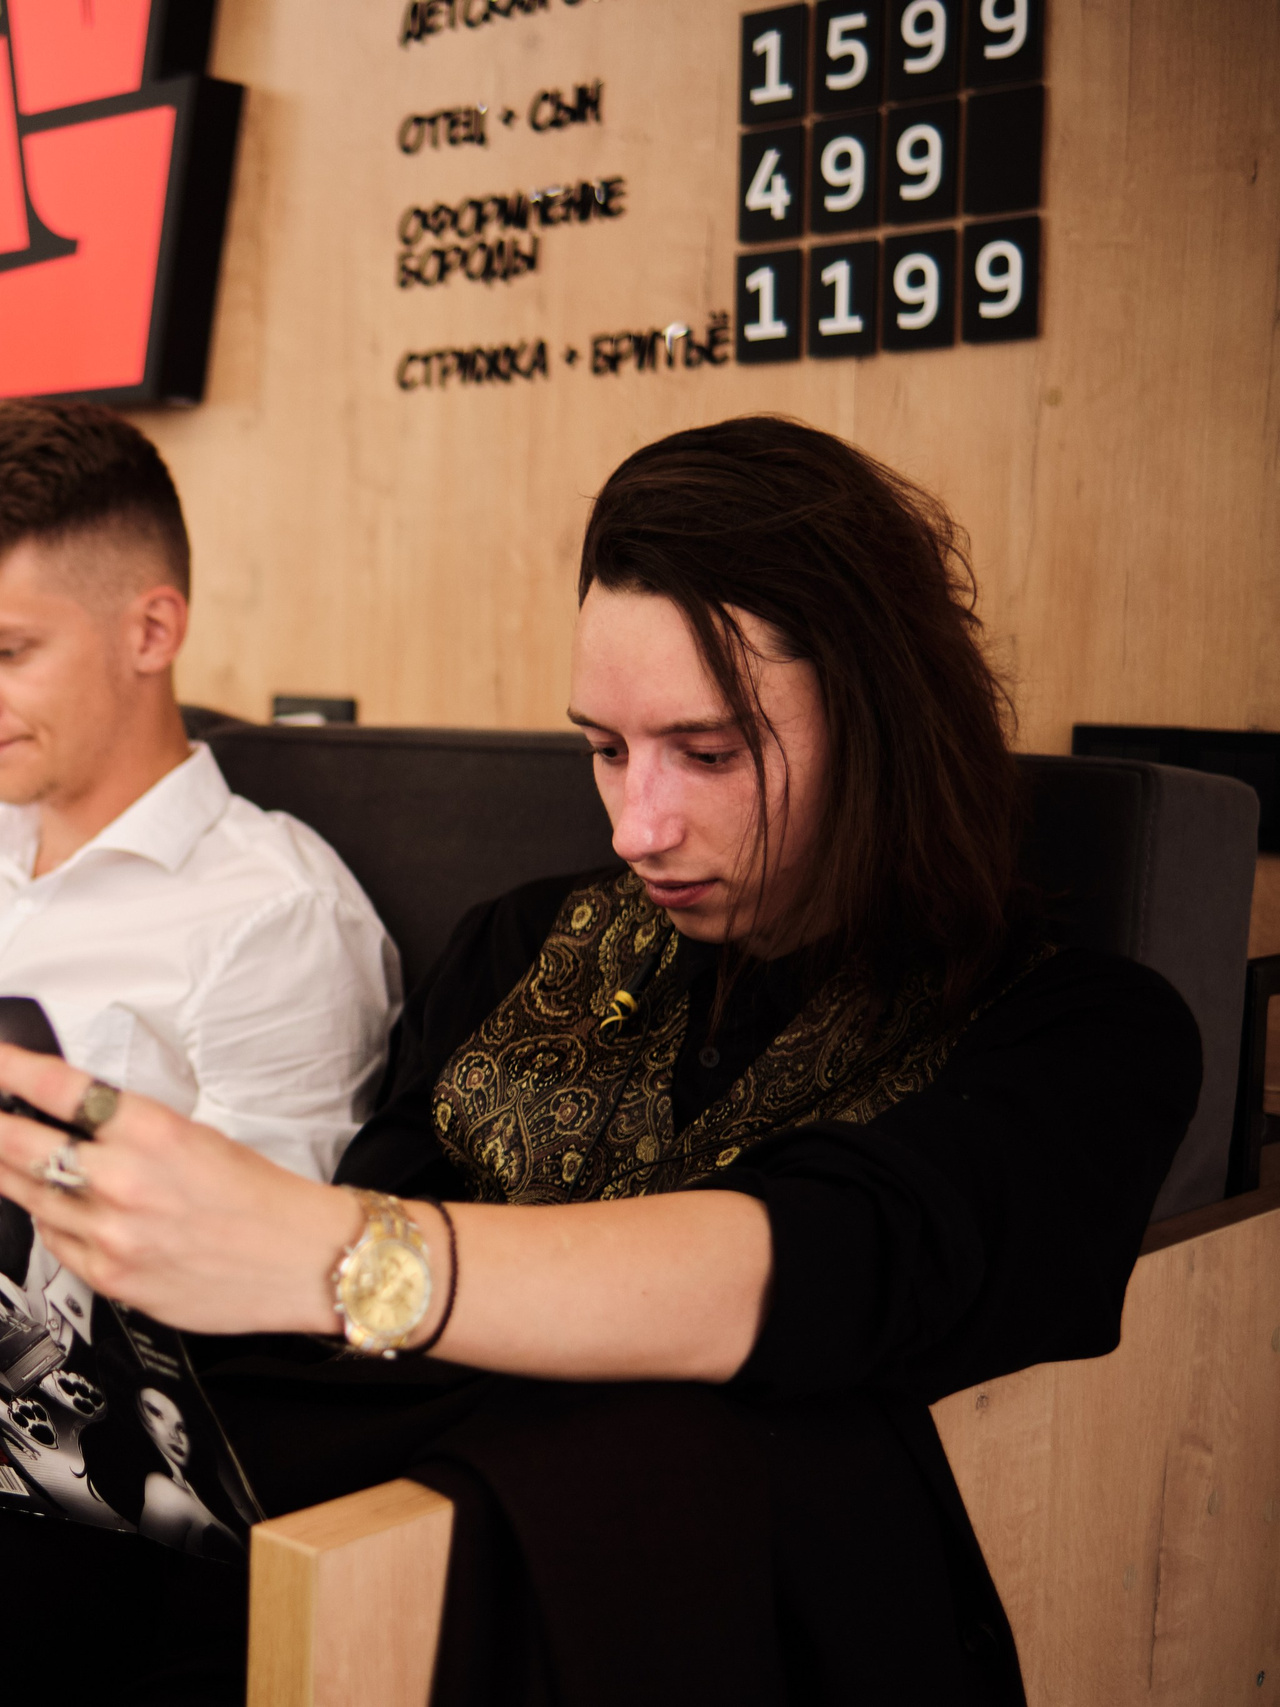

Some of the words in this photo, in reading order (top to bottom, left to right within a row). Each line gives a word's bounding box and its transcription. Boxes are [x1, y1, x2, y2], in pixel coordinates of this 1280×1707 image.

[750, 0, 1030, 105] 1599
[399, 106, 488, 153] ОТЕЦ
[529, 79, 603, 132] СЫН
[745, 124, 943, 221] 499
[398, 234, 539, 287] БОРОДЫ
[744, 241, 1023, 342] 1199
[397, 338, 549, 391] СТРИЖКА
